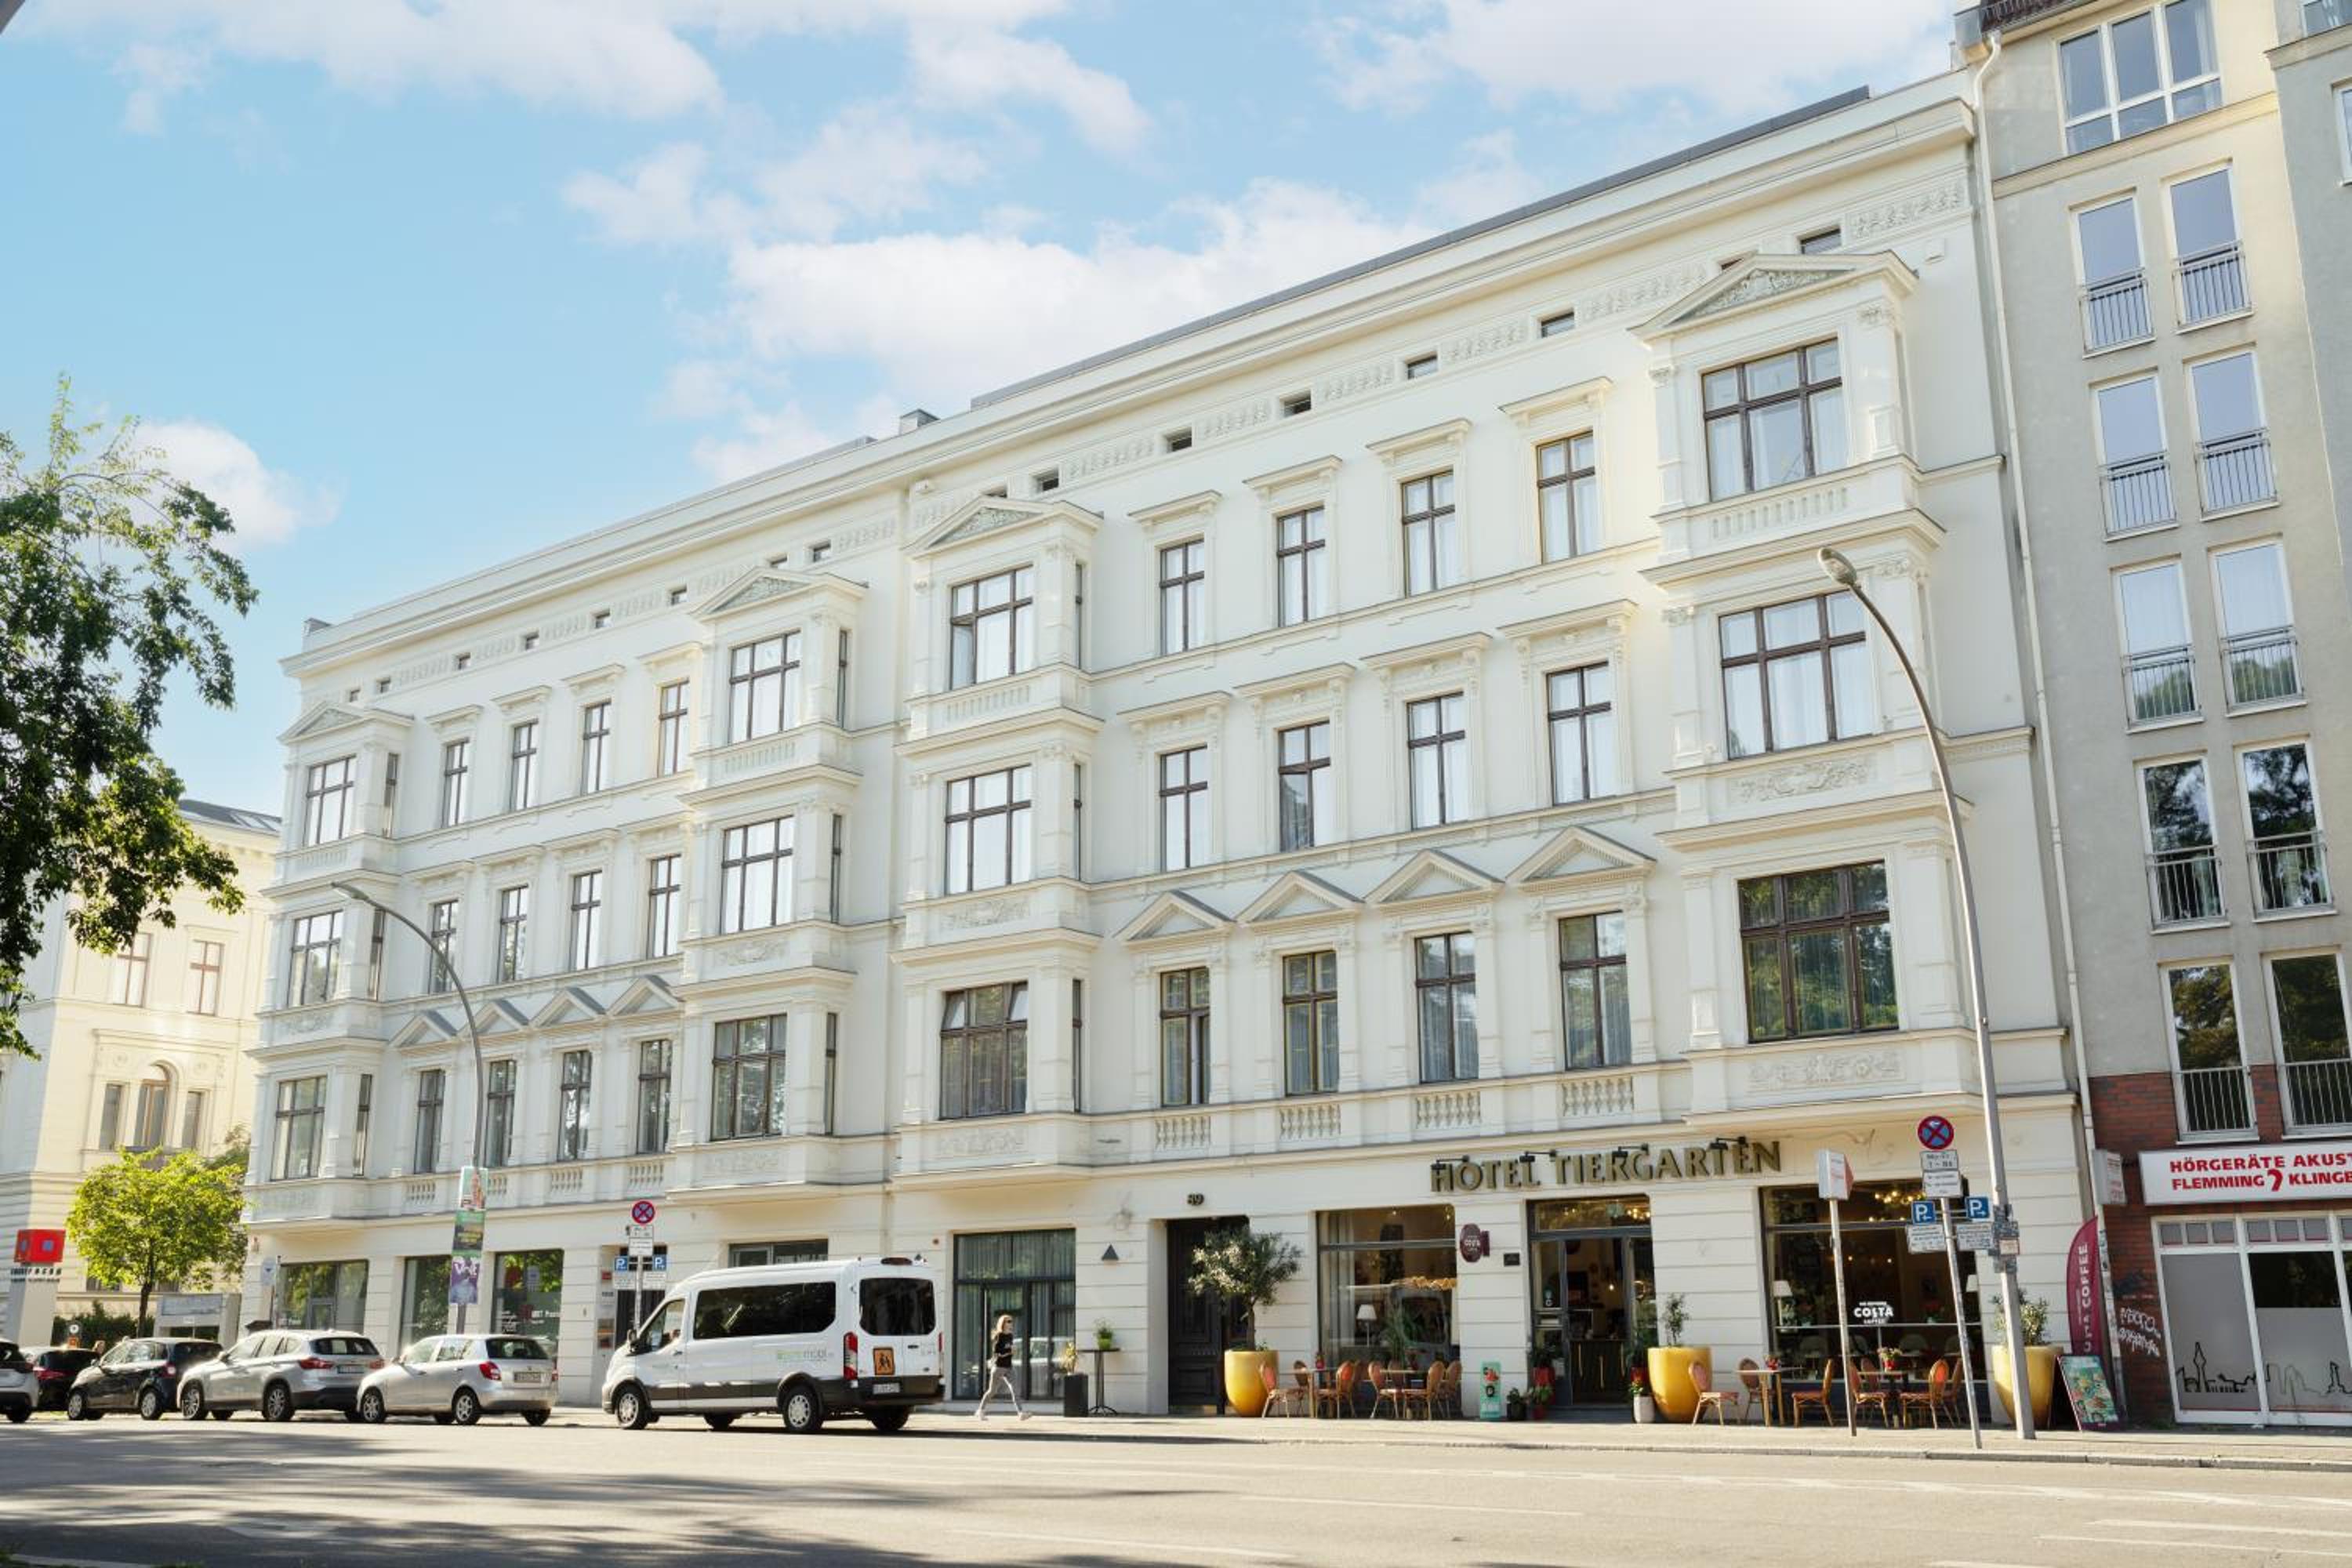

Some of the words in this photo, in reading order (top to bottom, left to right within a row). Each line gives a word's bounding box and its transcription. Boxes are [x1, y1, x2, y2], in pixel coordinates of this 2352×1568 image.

[1431, 1158, 1540, 1192] HOTEL
[1555, 1141, 1781, 1184] TIERGARTEN
[2170, 1154, 2285, 1173] HÖRGERÄTE
[2172, 1175, 2265, 1190] FLEMMING
[1915, 1204, 1928, 1221] P
[1969, 1200, 1983, 1217] P
[2078, 1243, 2092, 1308] COFFEE
[1853, 1307, 1893, 1317] COSTA
